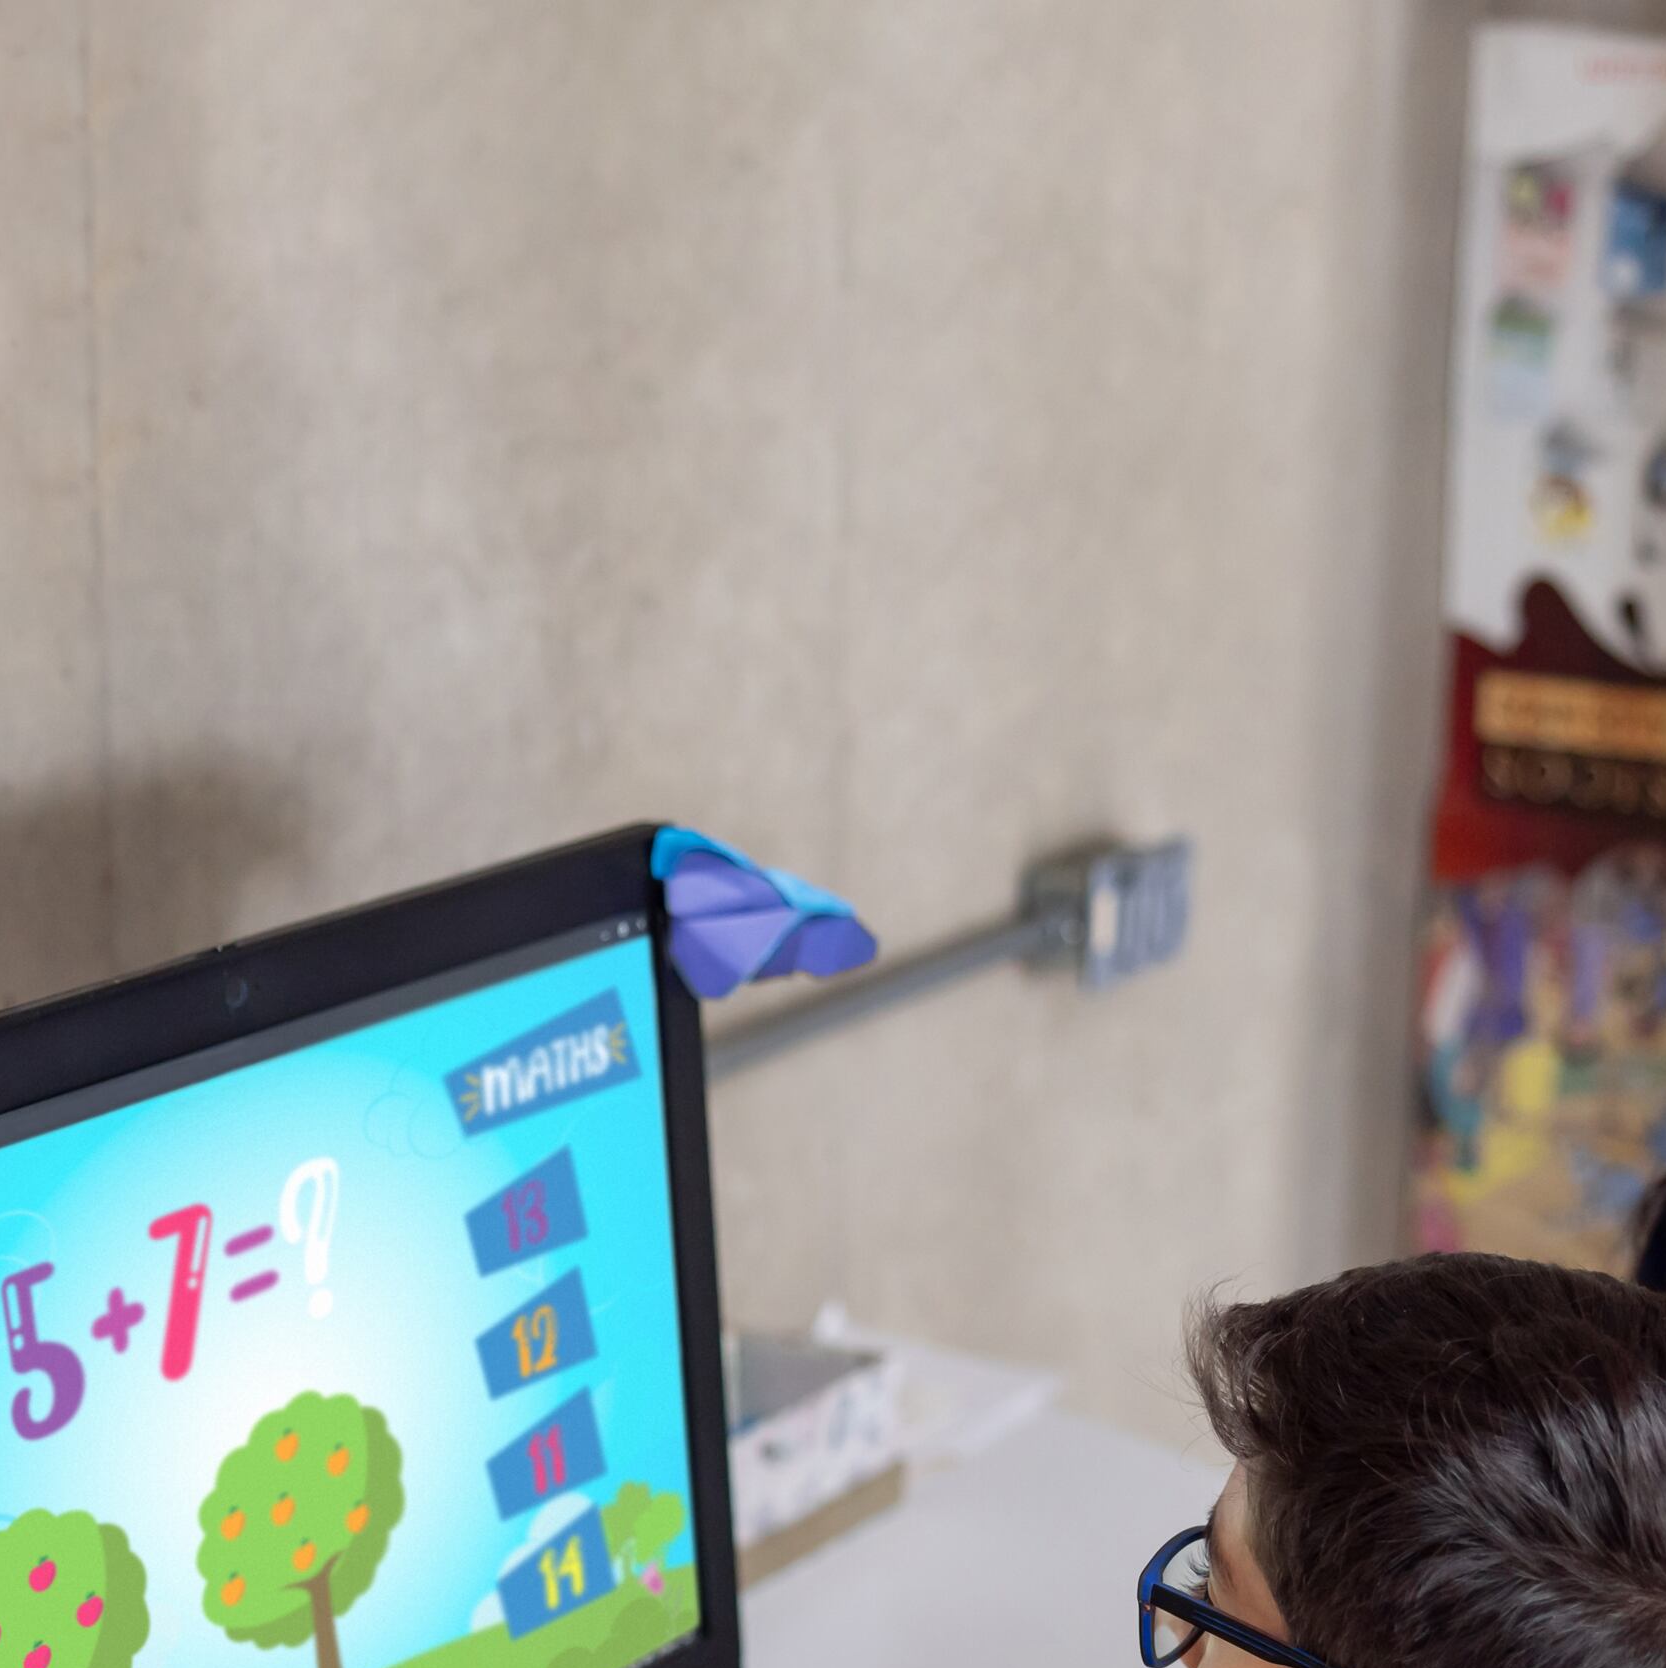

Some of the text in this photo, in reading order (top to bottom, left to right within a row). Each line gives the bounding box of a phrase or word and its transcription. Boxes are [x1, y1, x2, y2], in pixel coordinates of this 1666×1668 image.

[481, 1023, 610, 1117] MATHS
[501, 1179, 550, 1253] 13
[511, 1304, 558, 1379] 12
[528, 1424, 567, 1495] 11
[539, 1535, 585, 1611] 14
